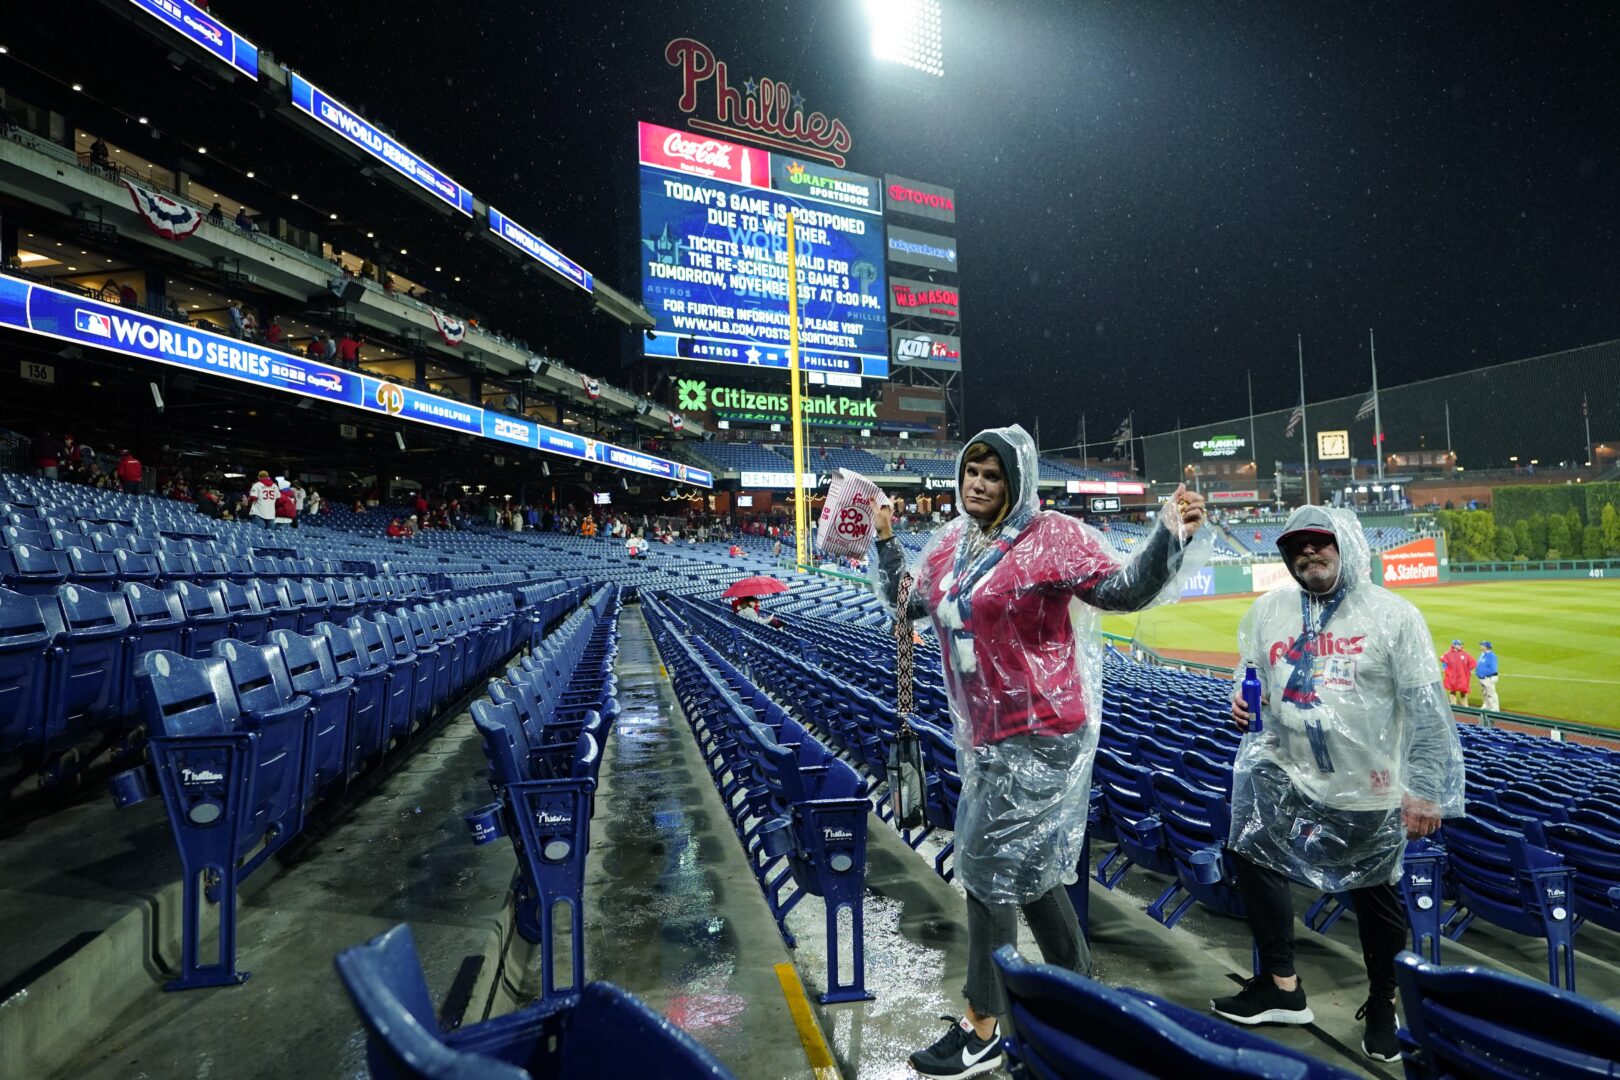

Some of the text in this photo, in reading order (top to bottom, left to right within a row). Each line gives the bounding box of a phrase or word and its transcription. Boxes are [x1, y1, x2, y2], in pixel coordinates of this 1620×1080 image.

[665, 37, 851, 152] Phillies
[337, 110, 382, 151] WORLD
[383, 141, 418, 174] SERIES
[790, 172, 869, 197] DRAFTKINGS
[664, 180, 865, 235] TODAY'S GAME IS POSTPONED
[810, 186, 869, 207] SPORTSBOOK
[906, 189, 955, 212] TOYOTA
[708, 208, 831, 246] DUE TO WETHER.
[688, 235, 849, 275] TICKETS WILL BE VALID FOR
[688, 252, 713, 269] THE
[716, 256, 805, 283] RE-SCHEDULD
[808, 271, 839, 289] GAME
[842, 277, 849, 290] 3
[647, 285, 691, 297] ASTROS
[649, 262, 727, 290] TOMORROW,
[797, 283, 817, 301] 1ST
[820, 288, 833, 302] AT
[836, 290, 859, 306] 8:00
[862, 295, 881, 310] PM.
[663, 299, 685, 313] FOR
[687, 302, 734, 320] FURTHER
[805, 317, 839, 333] PLEASE
[841, 322, 864, 335] VISIT
[847, 311, 886, 322] PHILLIES
[673, 315, 858, 348] WWW.MLB.COM/POSTSASONTICKETS.
[111, 315, 204, 361] WORLD
[206, 342, 272, 378] SERIES
[271, 365, 306, 382] 2022
[693, 344, 738, 357] ASTROS
[29, 365, 47, 380] 136
[804, 355, 850, 369] PHILLIES
[414, 401, 472, 424] PHILADELPHIA
[711, 387, 789, 412] Citizens
[839, 397, 877, 418] Park
[495, 418, 529, 442] 2022
[743, 474, 812, 485] DENTISTY
[263, 490, 275, 500] 35
[840, 508, 863, 524] POP
[838, 522, 868, 537] CORN
[1589, 569, 1603, 578] 401
